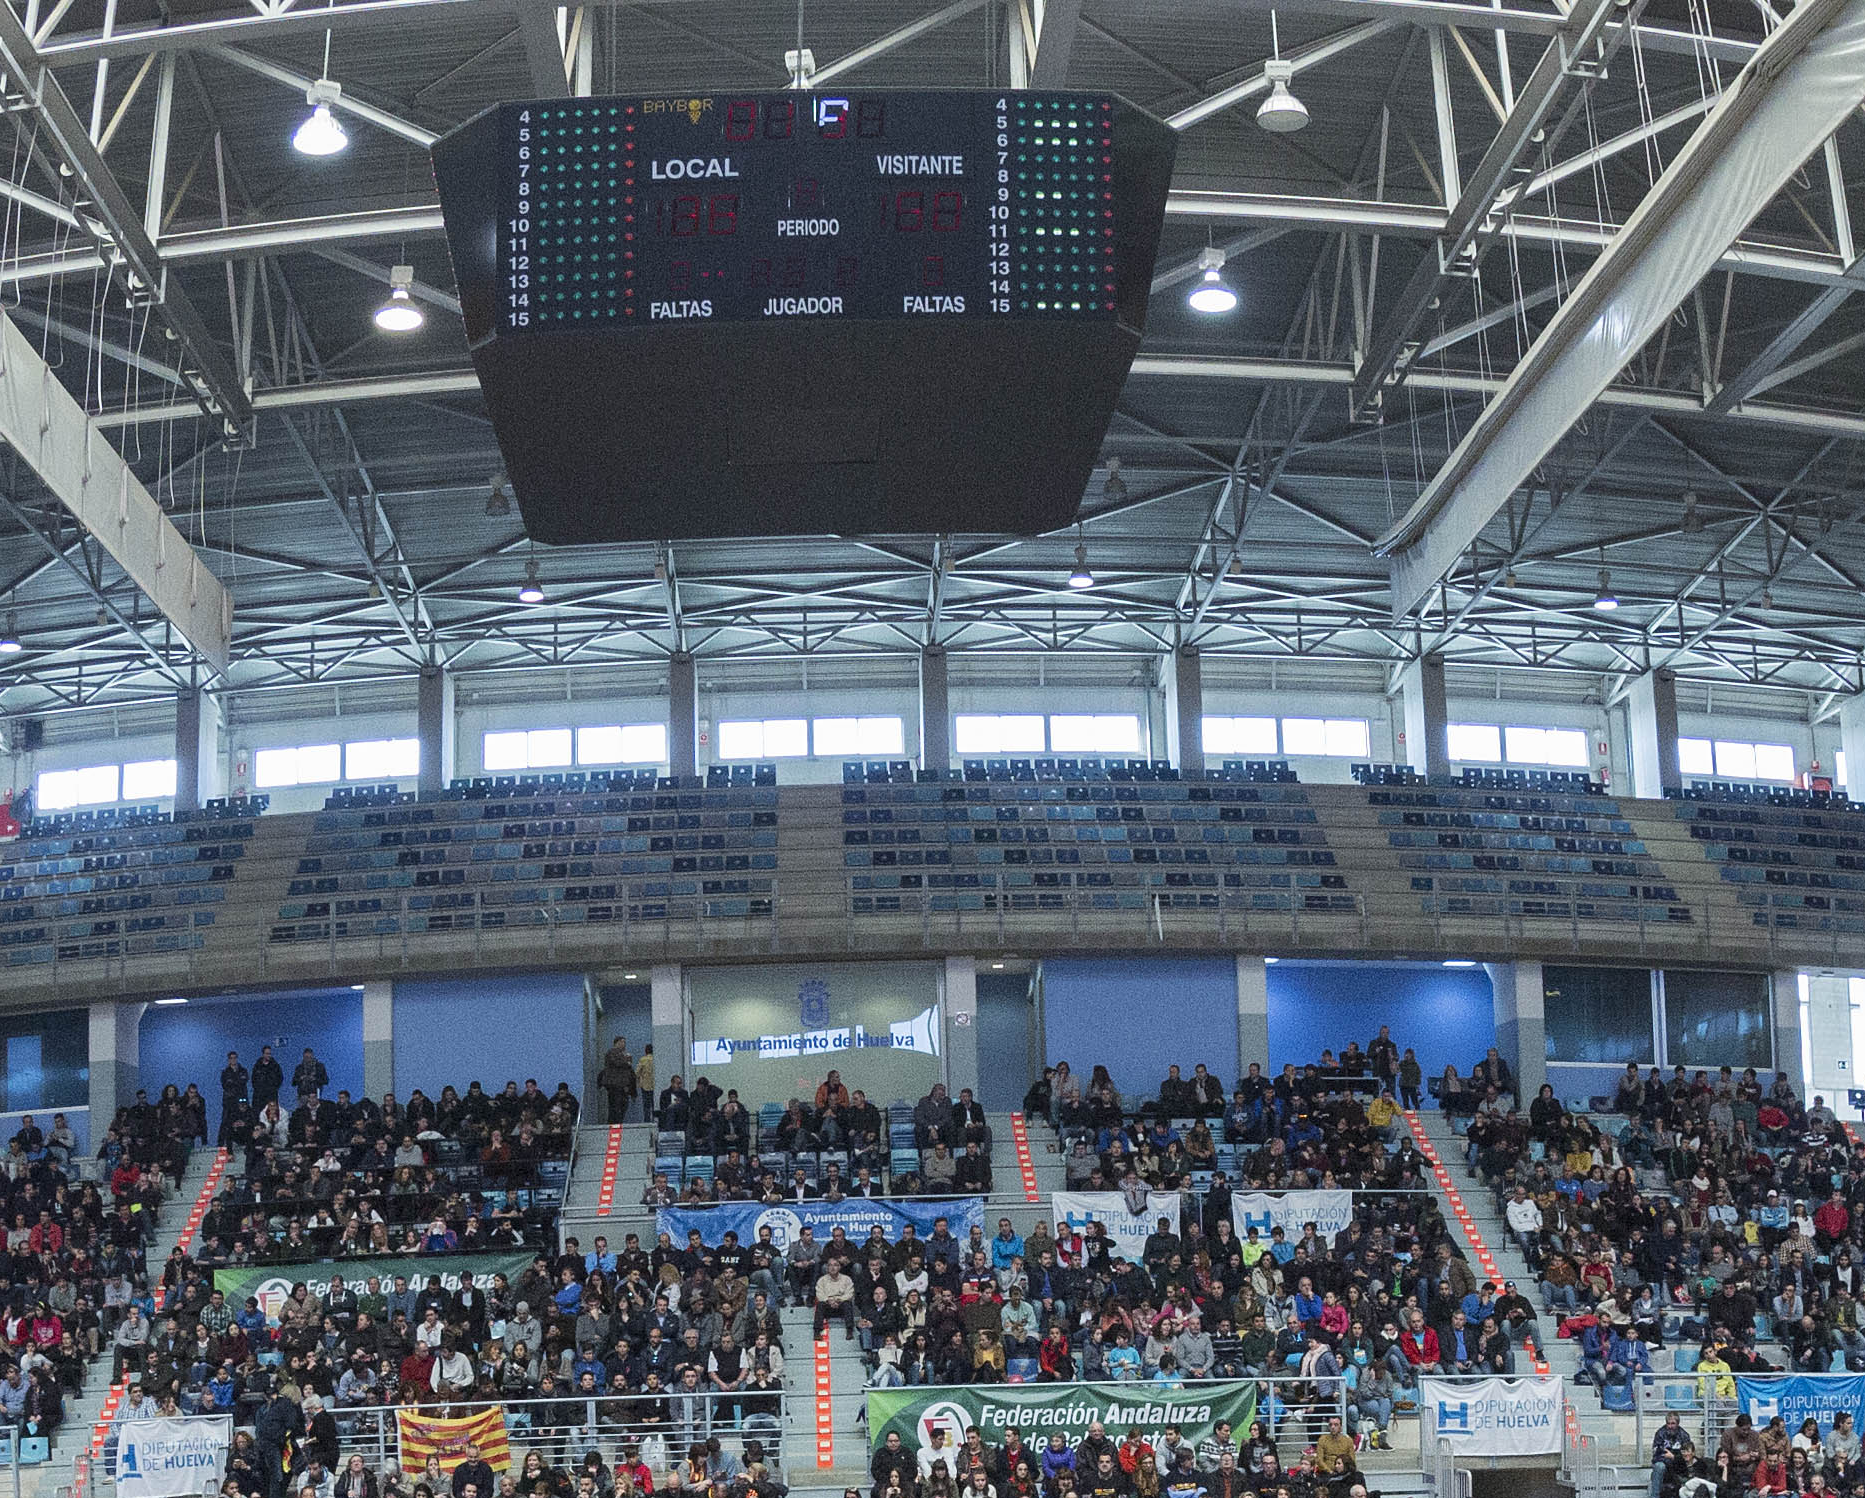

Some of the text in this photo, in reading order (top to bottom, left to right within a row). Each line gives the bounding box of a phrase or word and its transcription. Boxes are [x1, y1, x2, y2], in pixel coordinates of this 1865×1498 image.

[996, 99, 1007, 111] 4
[519, 111, 530, 123] 4
[997, 117, 1007, 129] 5
[520, 129, 530, 141] 5
[997, 135, 1007, 147] 6
[520, 147, 530, 159] 6
[997, 152, 1008, 164] 7
[519, 165, 529, 177] 7
[652, 158, 739, 179] LOCAL
[877, 155, 963, 175] VISITANTE
[998, 170, 1008, 182] 8
[519, 183, 529, 195] 8
[998, 188, 1008, 201] 9
[519, 201, 529, 214] 9
[989, 206, 1009, 219] 10
[509, 220, 529, 232] 10
[777, 219, 839, 236] PERIODO
[989, 225, 1008, 237] 11
[509, 238, 529, 251] 11
[989, 244, 1009, 256] 12
[509, 257, 529, 270] 12
[990, 262, 1010, 275] 13
[509, 275, 529, 288] 13
[990, 281, 1010, 293] 14
[508, 294, 529, 307] 14
[764, 297, 843, 315] JUGADOR
[903, 295, 965, 313] FALTAS
[990, 299, 1010, 312] 15
[651, 300, 712, 318] FALTAS
[508, 313, 529, 326] 15
[716, 1030, 914, 1052] Ayuntamiento de Huelva
[804, 1212, 893, 1224] Ayuntamiento
[1094, 1209, 1169, 1225] DIPUTACIÓN
[1272, 1206, 1348, 1222] DIPUTACIÓN
[1474, 1399, 1557, 1414] DIPUTACIÓN
[1782, 1393, 1862, 1412] DIPUTACIÓN
[980, 1401, 1211, 1427] Federación Andaluza
[1783, 1411, 1800, 1425] DE
[1475, 1414, 1550, 1428] DE HUELVA
[142, 1438, 225, 1456] DIPUTACIÓN
[143, 1452, 216, 1471] DE HUELVA
